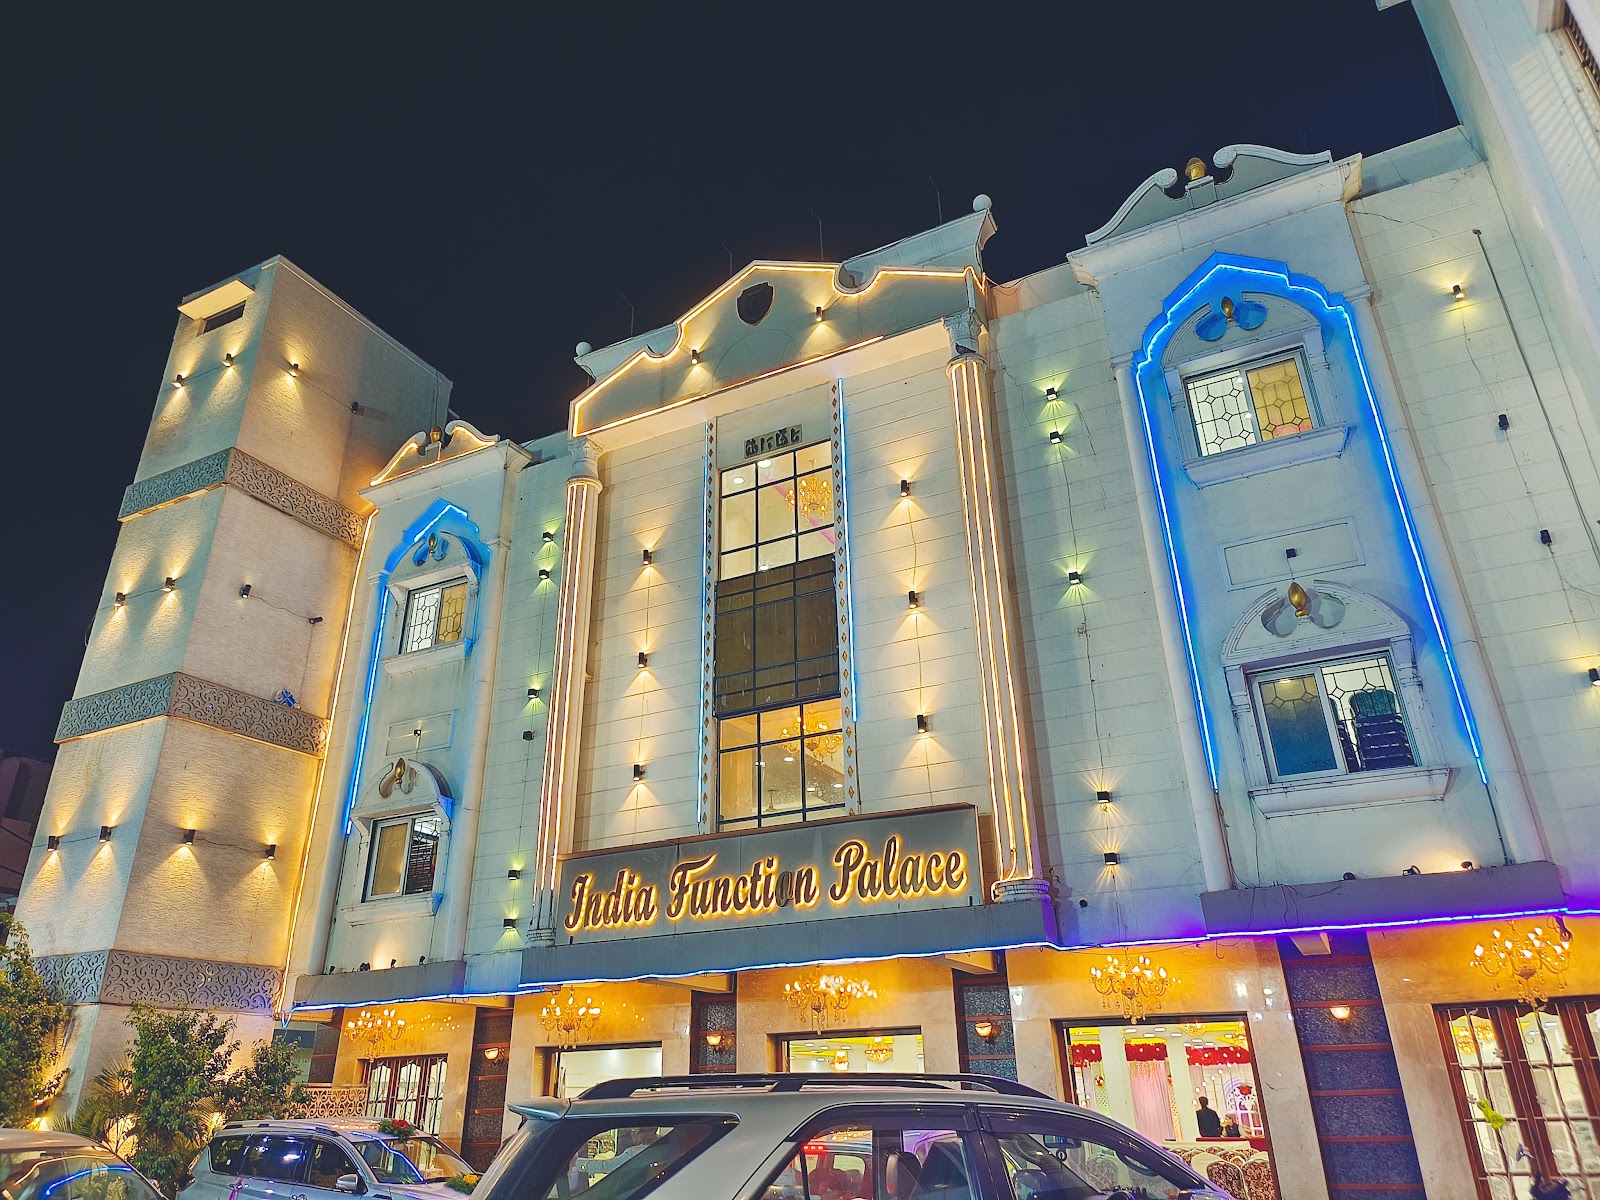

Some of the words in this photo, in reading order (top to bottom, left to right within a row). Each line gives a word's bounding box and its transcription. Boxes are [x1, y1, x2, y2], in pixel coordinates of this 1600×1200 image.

[564, 868, 657, 930] India
[666, 852, 820, 919] Function
[829, 834, 970, 902] Palace
